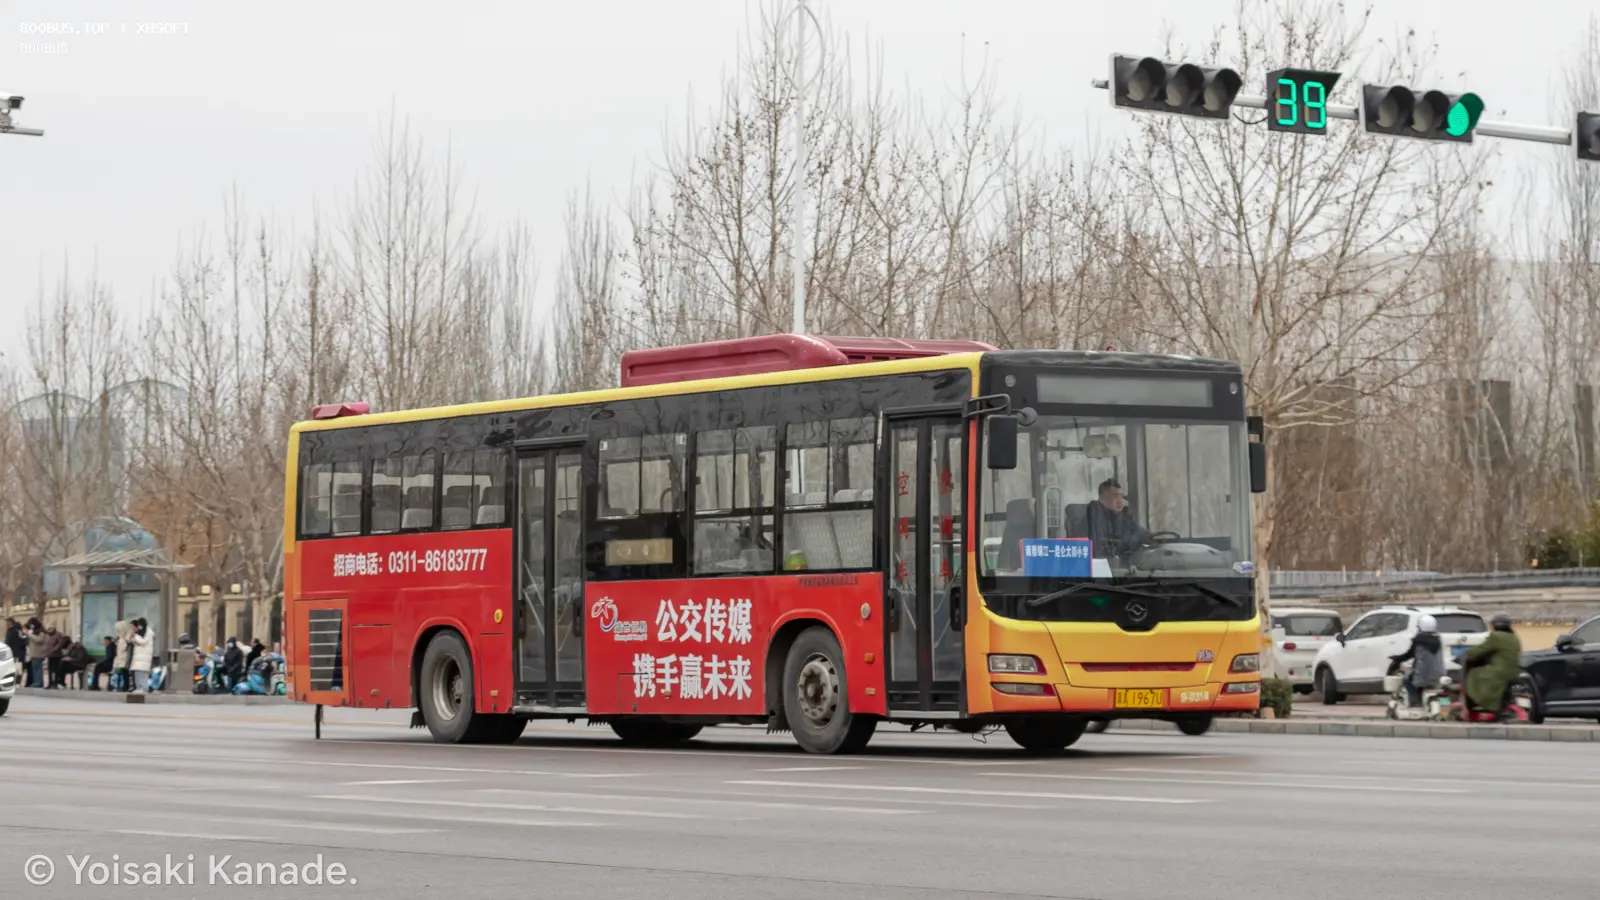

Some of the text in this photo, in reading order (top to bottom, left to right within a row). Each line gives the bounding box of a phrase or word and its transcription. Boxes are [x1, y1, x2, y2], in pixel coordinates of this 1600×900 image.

[1278, 79, 1325, 128] 39
[388, 548, 488, 574] 0311-86183777
[655, 598, 753, 645] 公交传媒
[632, 652, 753, 701] 携手赢未来
